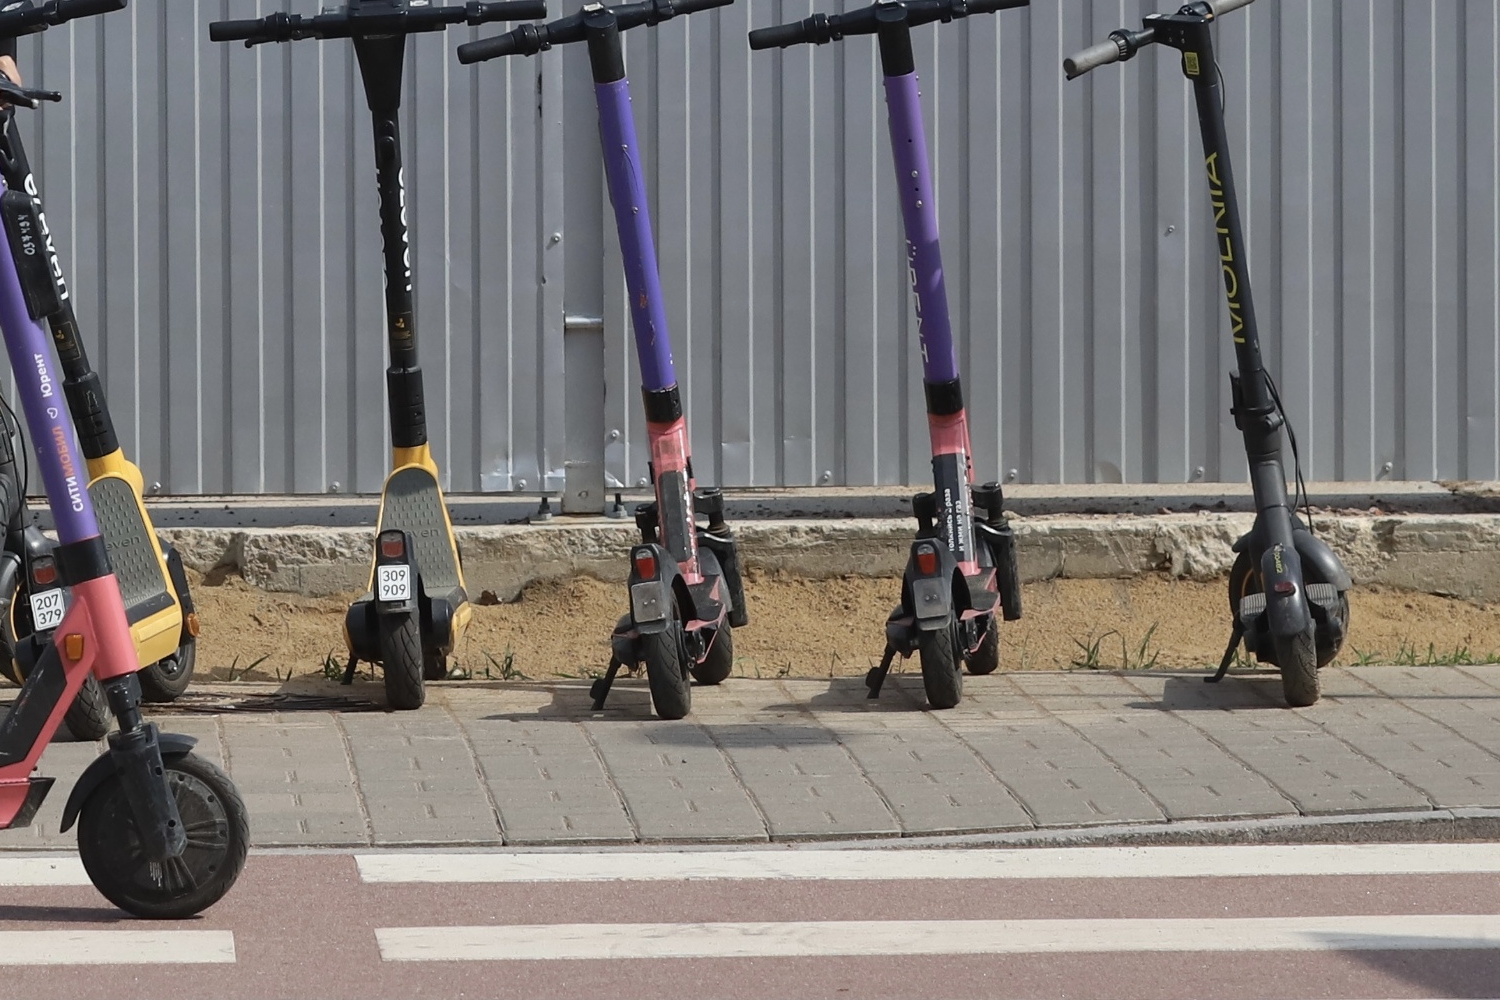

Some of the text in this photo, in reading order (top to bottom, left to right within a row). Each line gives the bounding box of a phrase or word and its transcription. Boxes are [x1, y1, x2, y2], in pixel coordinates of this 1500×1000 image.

[33, 353, 54, 398] Юрент
[382, 570, 406, 582] 309
[382, 584, 406, 596] 909
[35, 594, 59, 610] 207
[38, 609, 62, 625] 379
